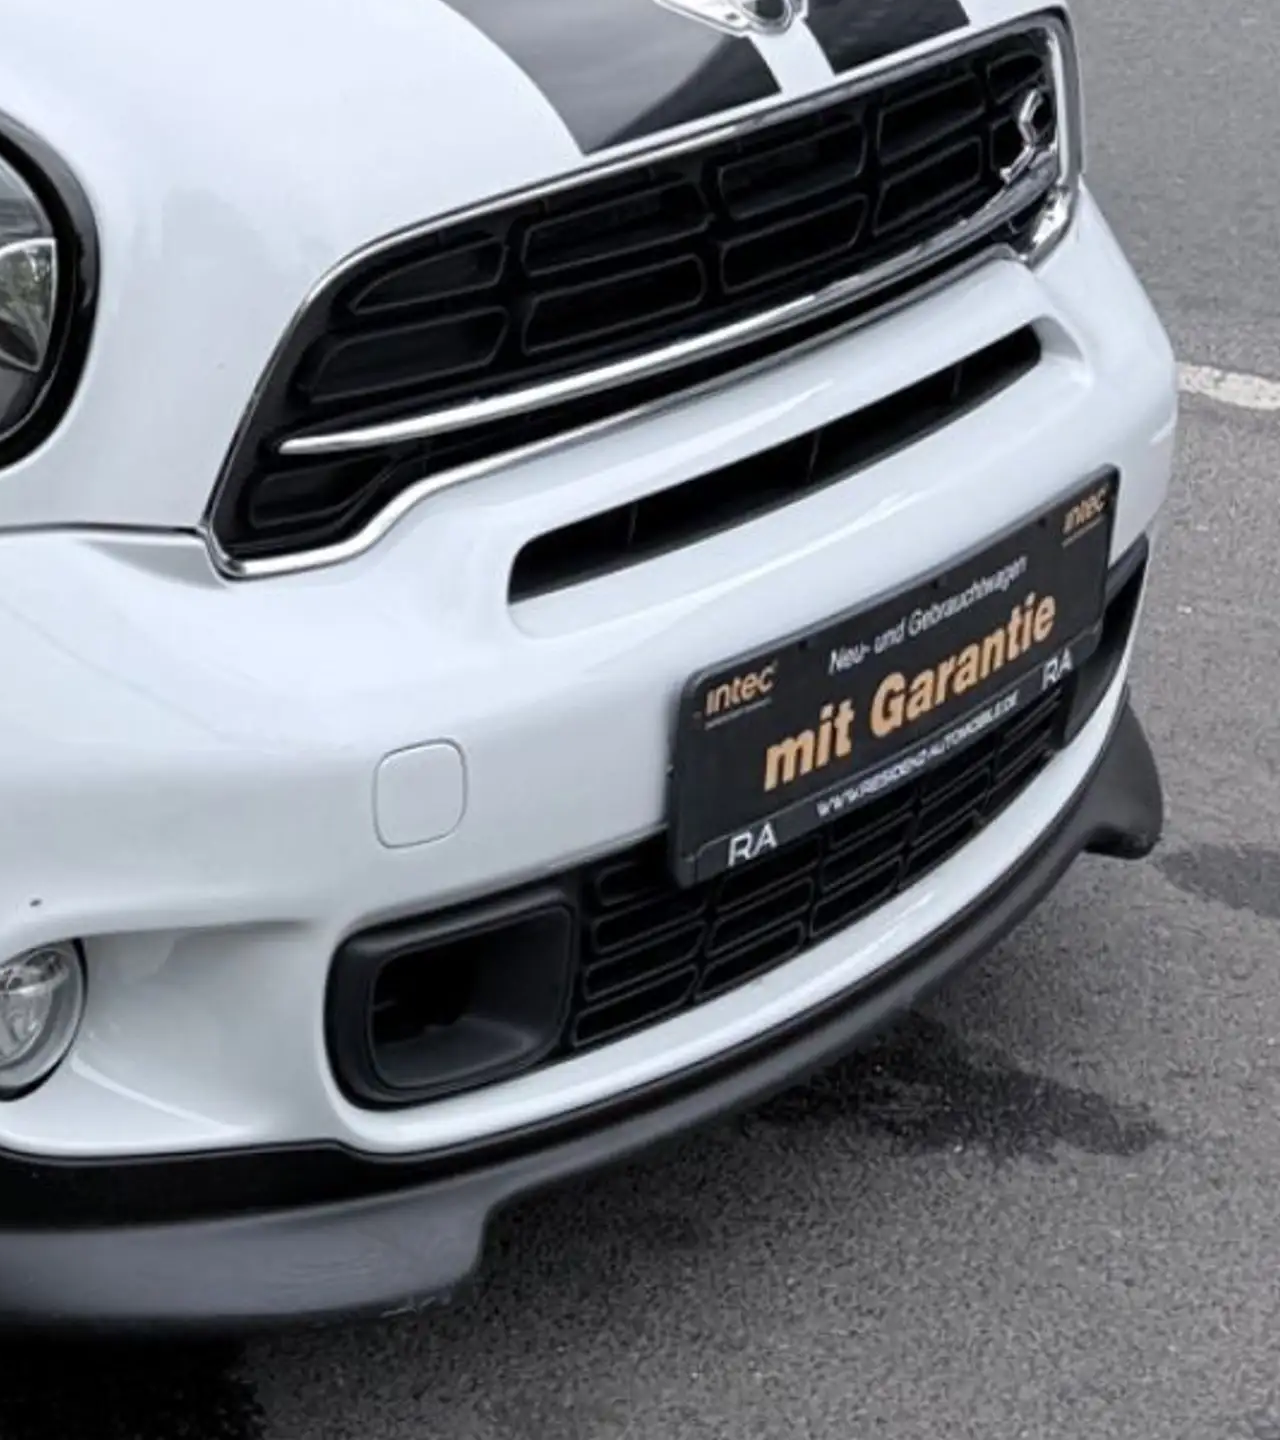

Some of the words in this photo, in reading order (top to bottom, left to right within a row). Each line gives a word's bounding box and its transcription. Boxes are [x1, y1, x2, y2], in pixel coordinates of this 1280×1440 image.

[827, 645, 871, 676] Neu-
[873, 617, 907, 655] und
[906, 555, 1030, 638] Gebrauchtwagen
[763, 696, 855, 792] mit
[870, 593, 1058, 737] Garantie
[1042, 648, 1074, 691] RA
[727, 823, 779, 867] RA
